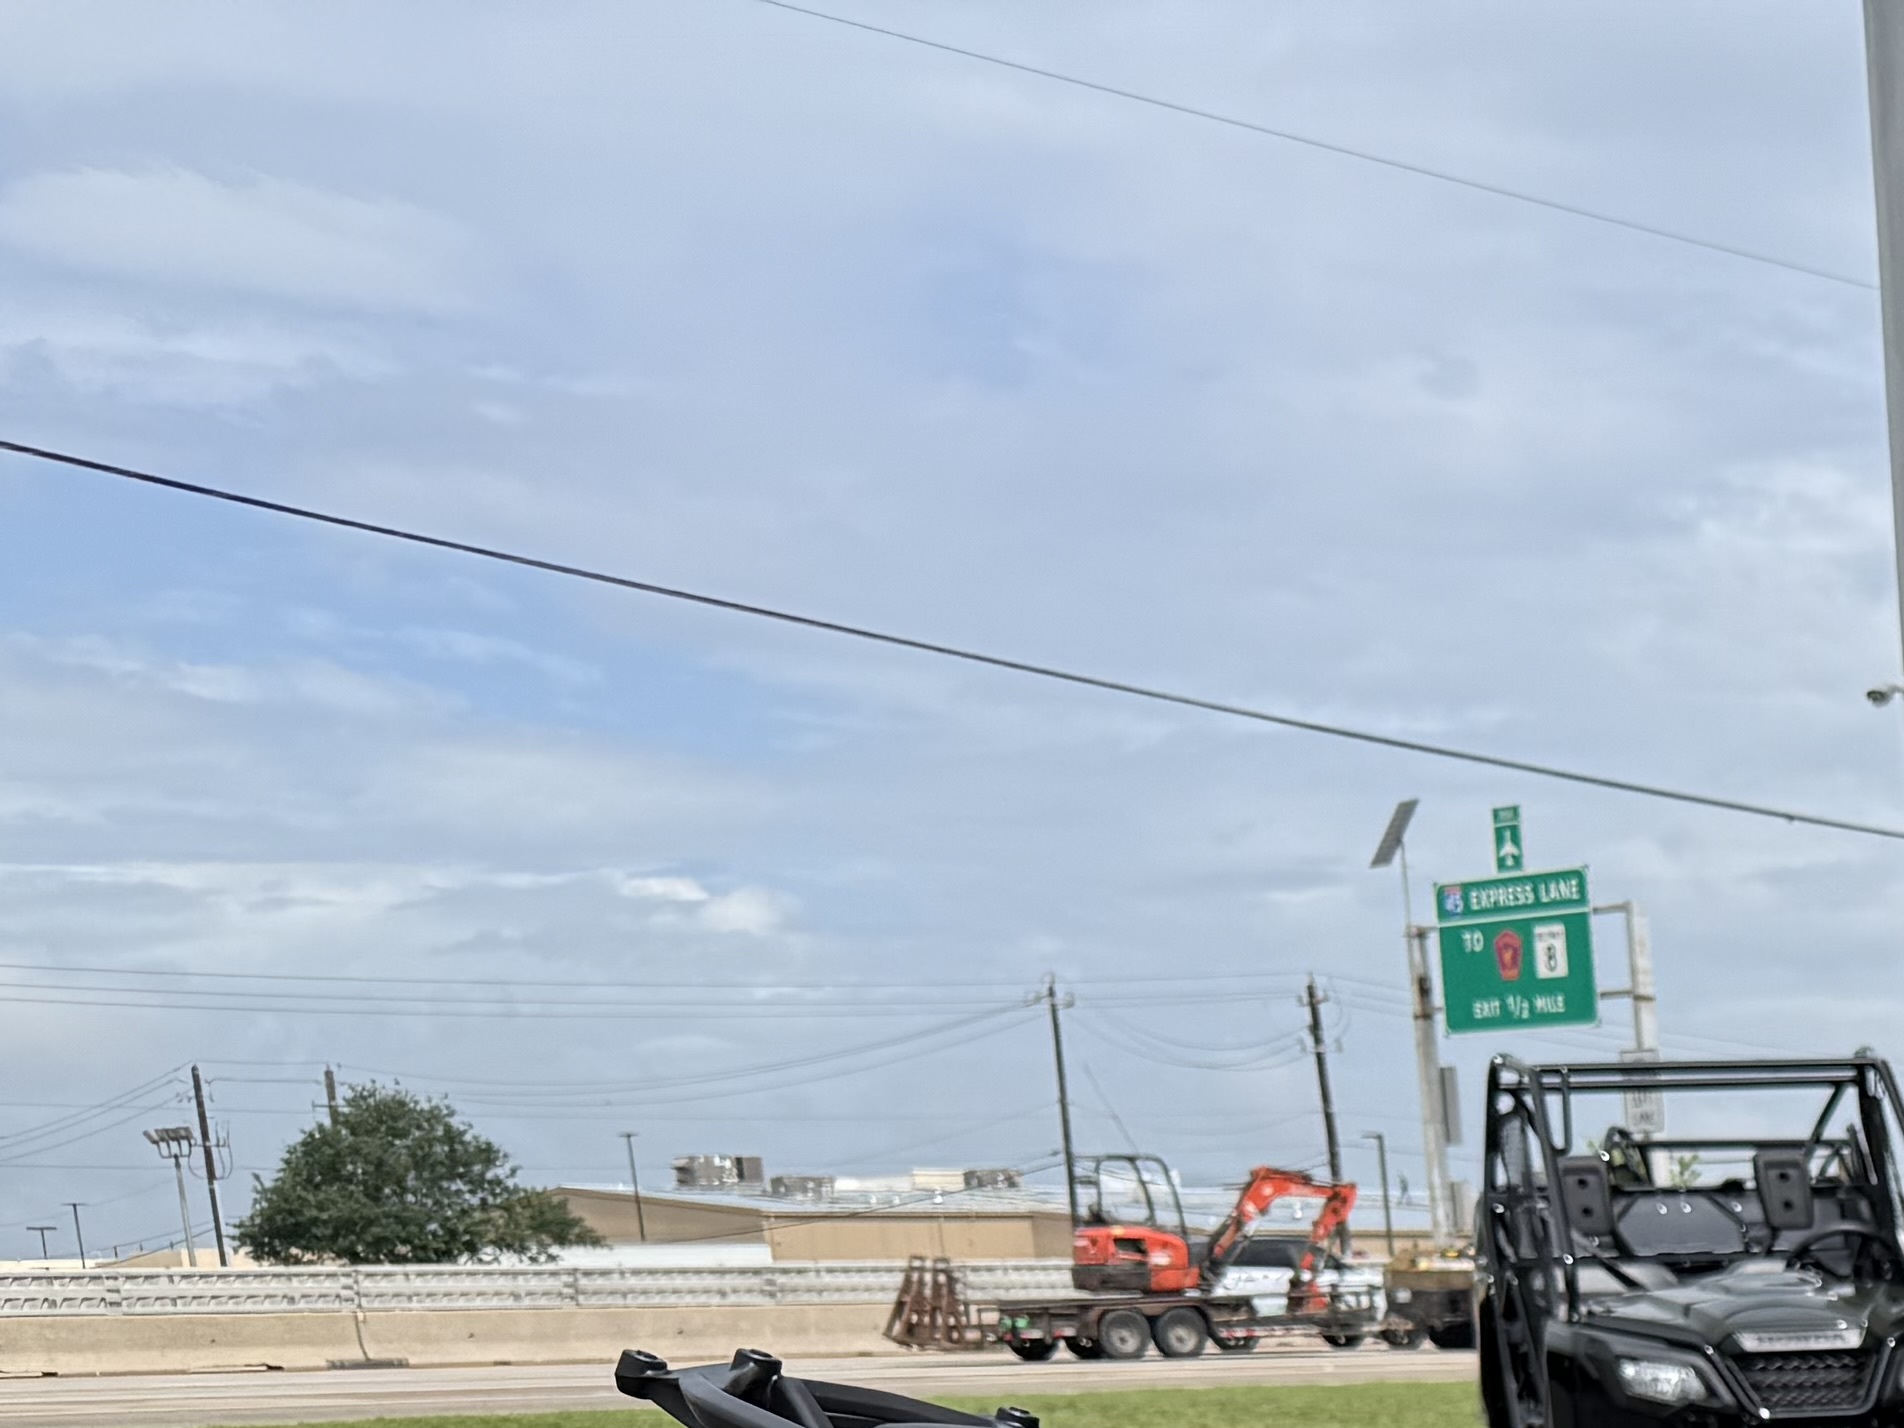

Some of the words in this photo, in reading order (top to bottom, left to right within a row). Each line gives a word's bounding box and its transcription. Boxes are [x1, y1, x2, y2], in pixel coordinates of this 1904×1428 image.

[1470, 882, 1535, 910] EXPRESS
[1539, 877, 1580, 904] LANE
[1461, 930, 1484, 953] TO
[1544, 943, 1558, 972] 8
[1473, 1000, 1500, 1019] EXIT
[1534, 995, 1566, 1014] MILE
